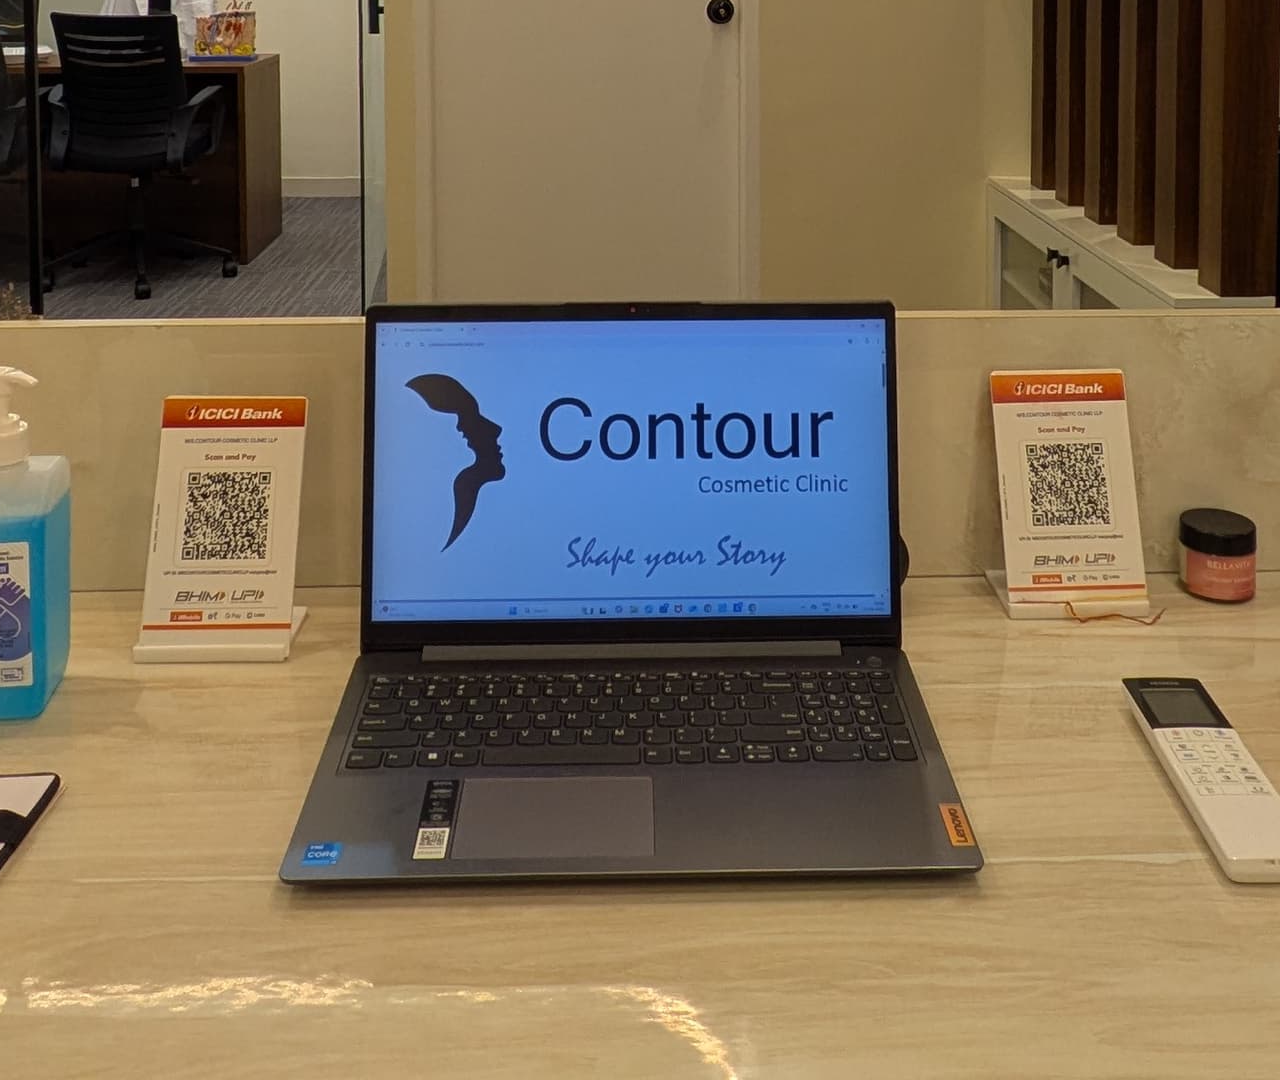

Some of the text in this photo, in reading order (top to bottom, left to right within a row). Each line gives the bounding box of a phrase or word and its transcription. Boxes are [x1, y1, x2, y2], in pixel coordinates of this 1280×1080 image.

[1025, 382, 1104, 396] ICICI Bank
[198, 407, 283, 421] ICICI Bank
[539, 396, 835, 462] Contour
[1037, 426, 1055, 434] Scan
[1072, 426, 1085, 434] Pay
[205, 453, 256, 462] Scan and Pay
[697, 473, 848, 494] Cosmetic Clinic
[566, 535, 787, 578] Shape your Story
[1034, 553, 1111, 566] BHIM UPI
[175, 589, 259, 602] BHIM UPI
[948, 808, 969, 843] Lenovo
